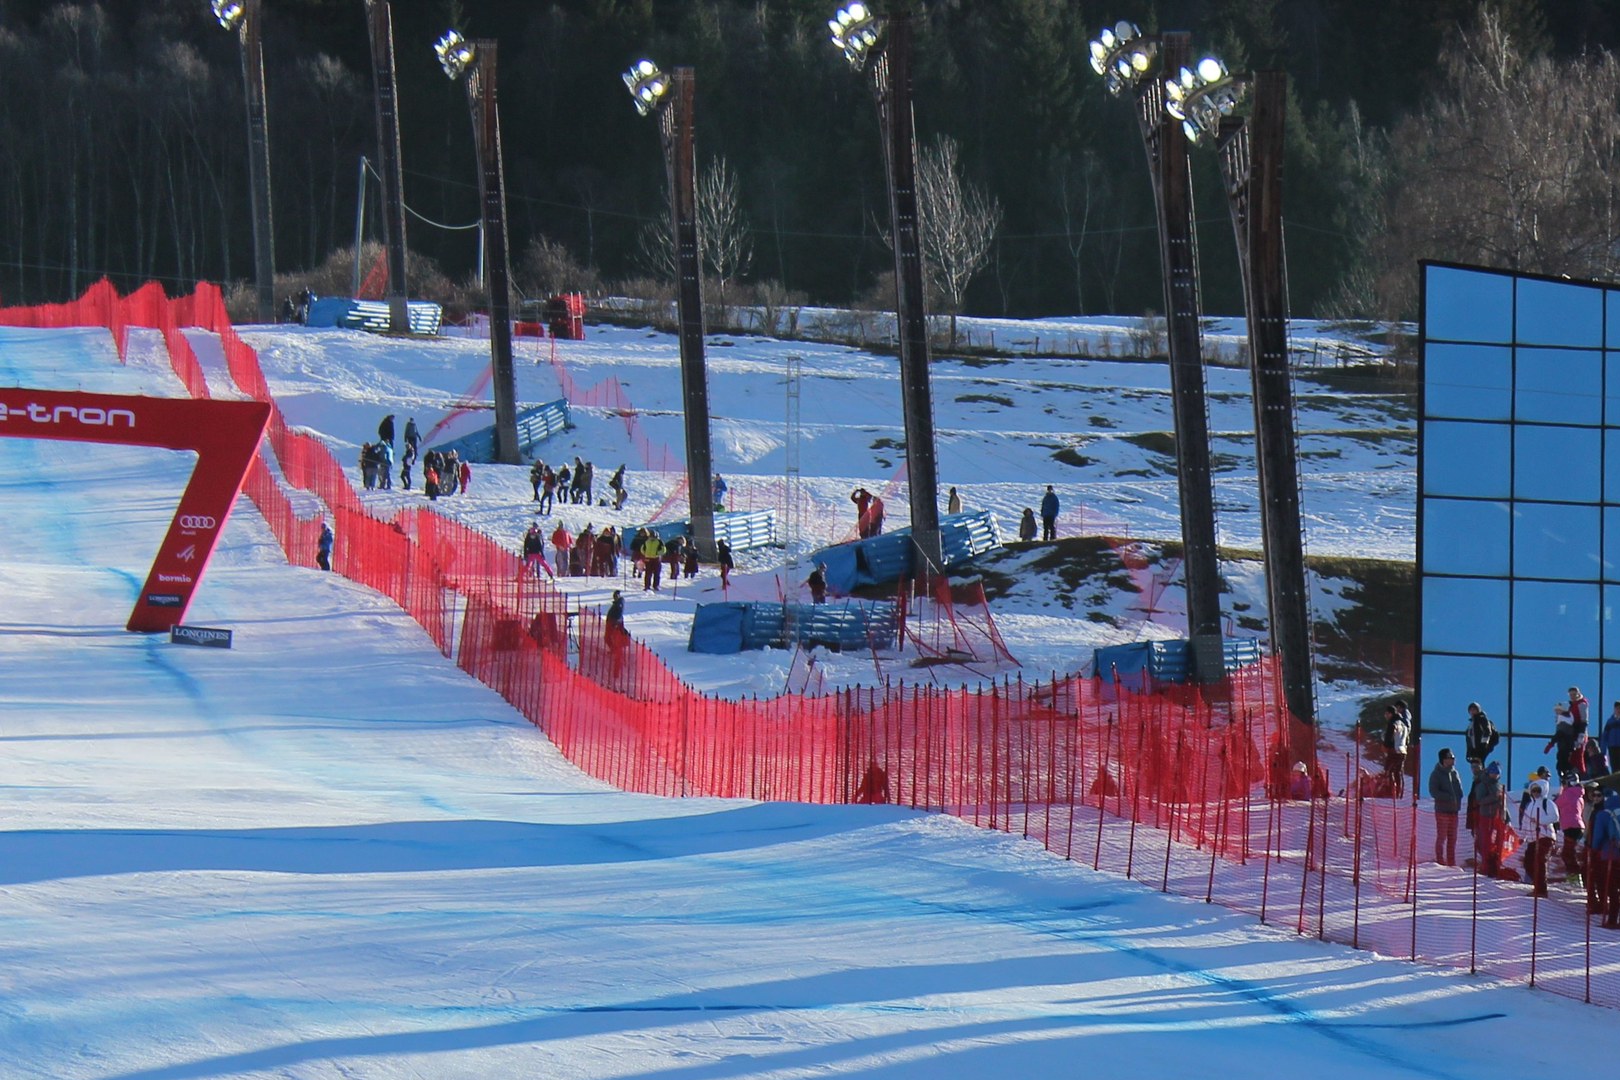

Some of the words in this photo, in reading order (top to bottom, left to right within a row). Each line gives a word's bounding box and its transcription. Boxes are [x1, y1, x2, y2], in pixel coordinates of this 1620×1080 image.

[0, 402, 136, 427] -tron
[158, 573, 192, 583] bormio
[175, 628, 230, 640] LONGINES
